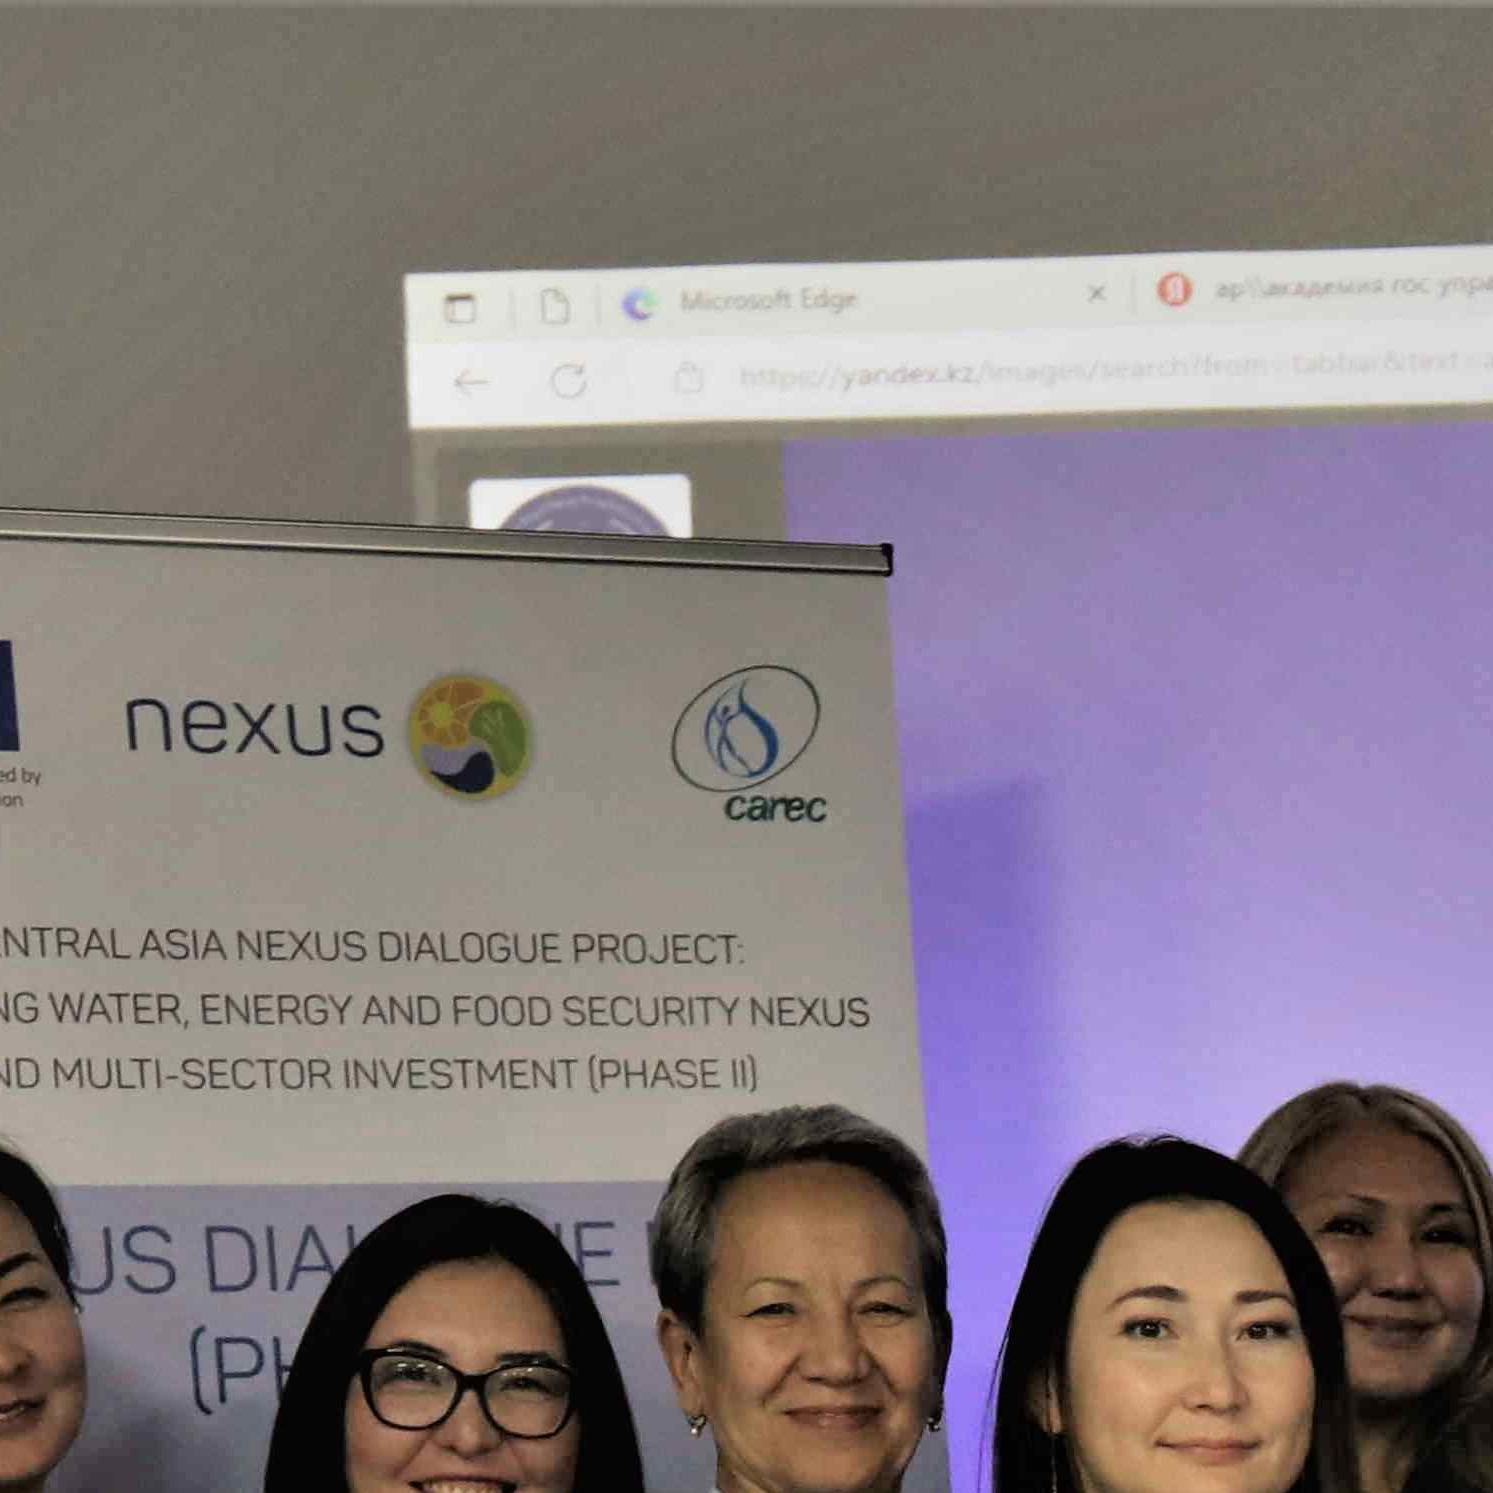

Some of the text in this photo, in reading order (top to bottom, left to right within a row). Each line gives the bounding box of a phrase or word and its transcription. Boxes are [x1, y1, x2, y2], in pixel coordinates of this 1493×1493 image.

[680, 286, 857, 315] Microsoft Edge
[126, 696, 386, 759] nexus
[21, 767, 42, 786] by
[724, 790, 828, 824] carec
[139, 928, 229, 961] ASIA
[237, 929, 368, 962] NEXUS
[378, 930, 562, 965] DIALOGUE
[573, 932, 746, 966] PROJECT:
[49, 992, 190, 1030] WATER,
[201, 993, 353, 1027] ENERGY
[362, 994, 442, 1027] AND
[452, 994, 553, 1028] FOOD
[562, 995, 741, 1028] SECURITY
[751, 996, 871, 1029] NEXUS
[53, 1057, 333, 1091] MULTI-SECTOR
[343, 1057, 579, 1091] INVESTMENT
[587, 1053, 722, 1095] (PHASE
[730, 1053, 760, 1094] II)
